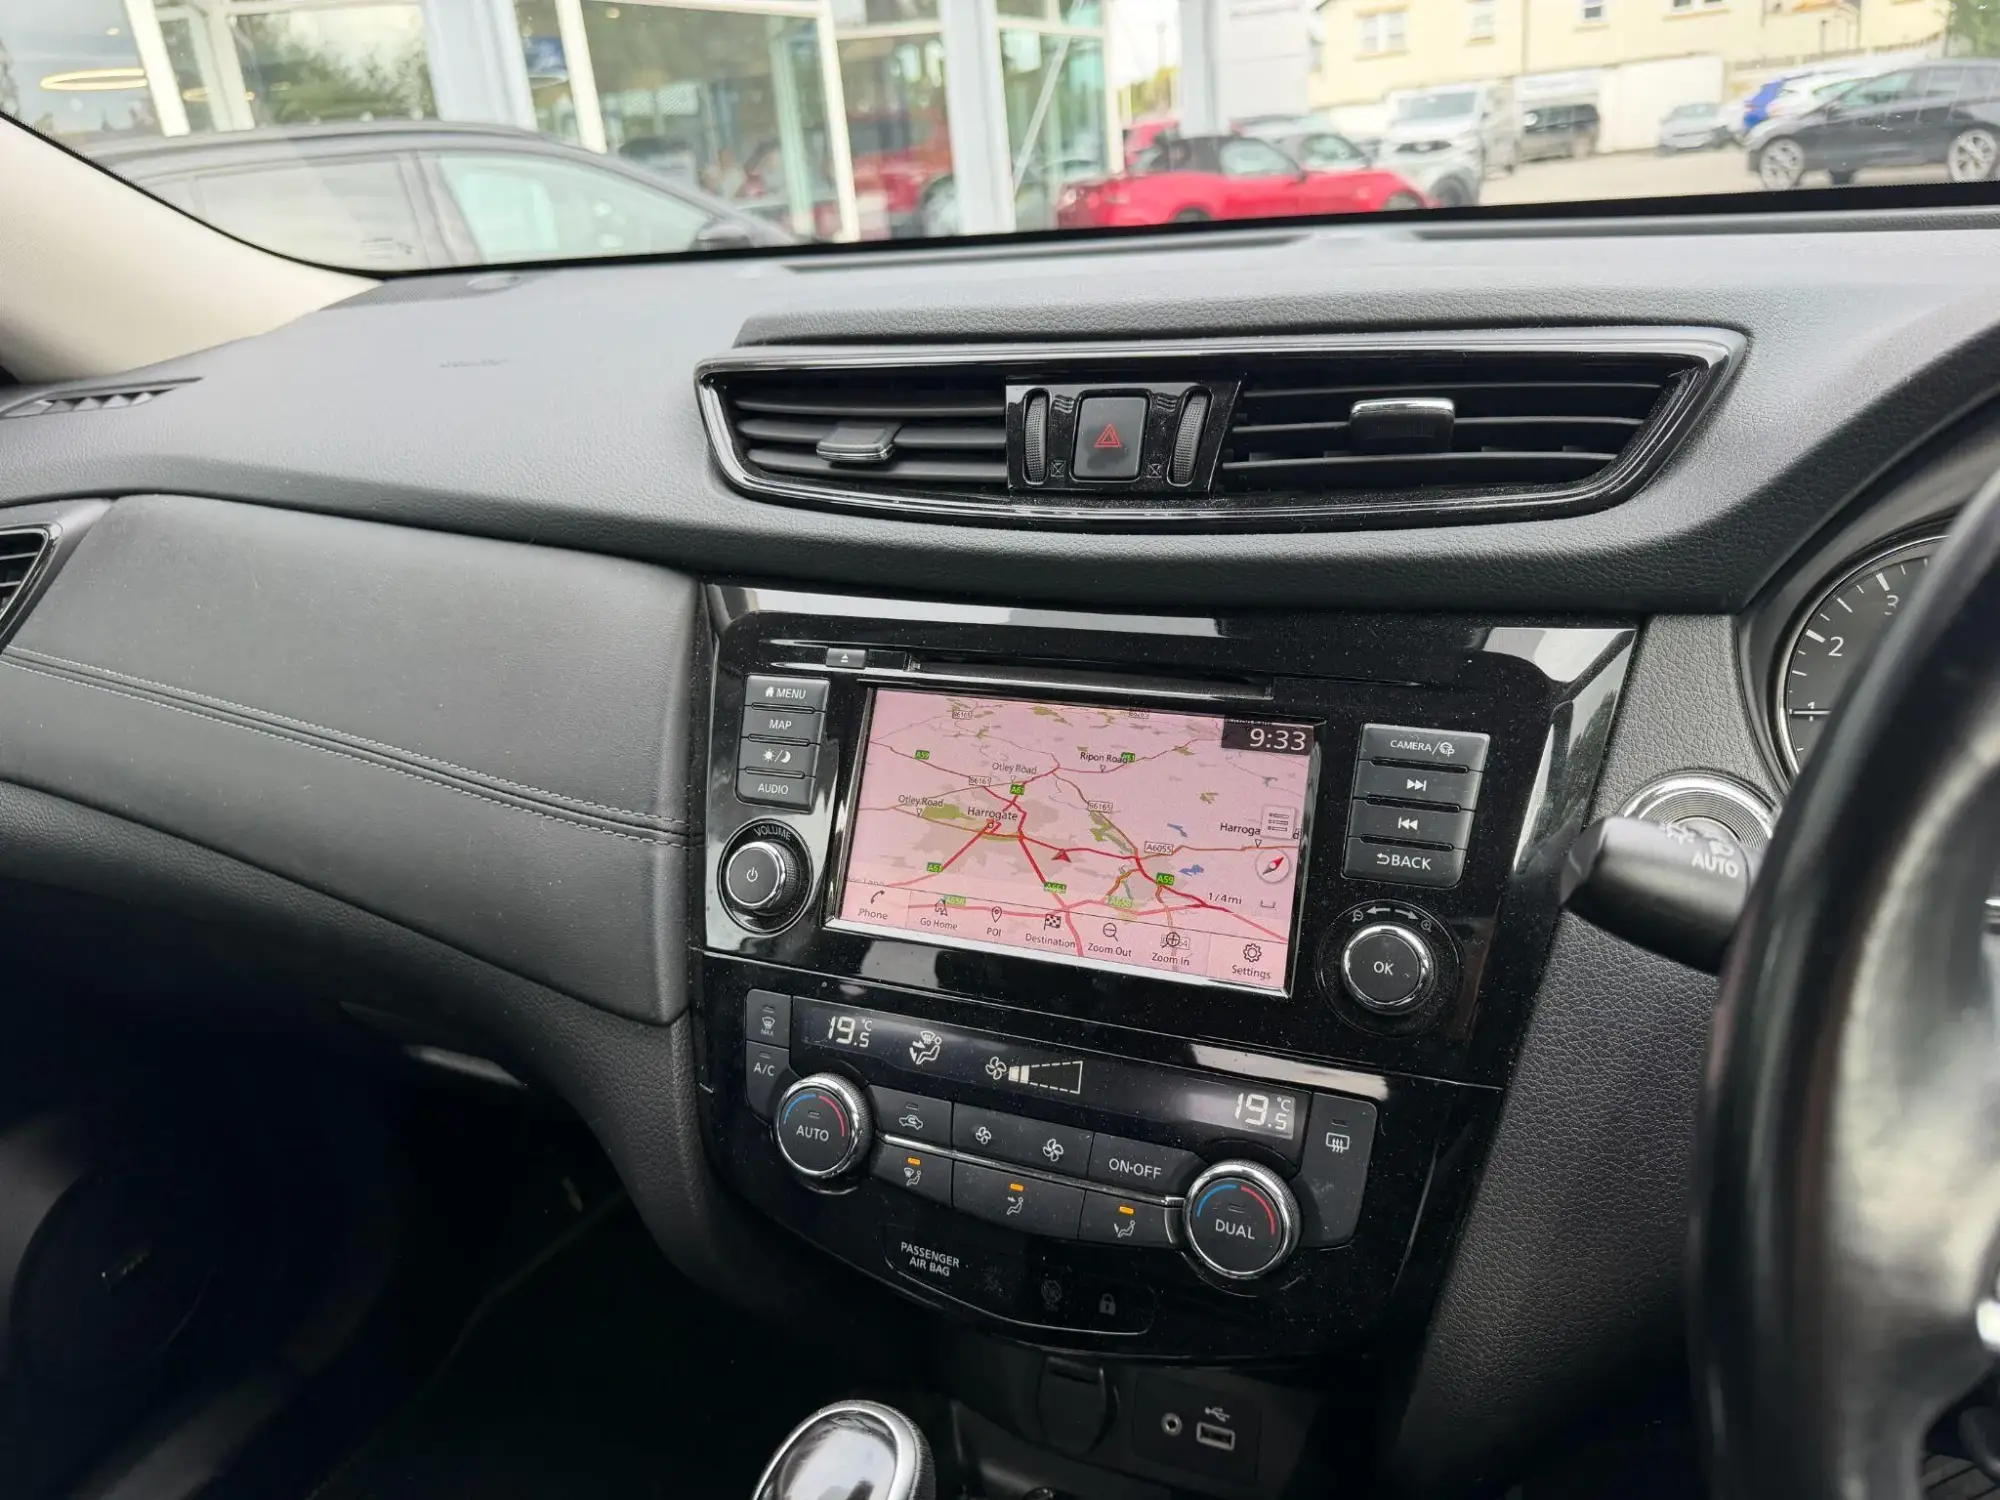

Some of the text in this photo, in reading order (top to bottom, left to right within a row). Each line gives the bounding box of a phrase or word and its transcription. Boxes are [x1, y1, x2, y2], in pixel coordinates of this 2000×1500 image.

[1828, 637, 1844, 656] 2
[776, 687, 807, 700] MENU
[769, 718, 792, 731] MAP
[1250, 728, 1307, 751] 9:33
[1080, 752, 1128, 764] Ripon Road
[992, 762, 1037, 775] Otley Road
[758, 783, 789, 795] AUDIO
[898, 795, 944, 808] Otley Road
[967, 806, 1019, 822] Harrogate
[753, 825, 791, 842] VOLUME
[1220, 822, 1261, 837] Harroga
[1146, 843, 1172, 853] A6055
[1391, 854, 1432, 870] BACK
[1691, 851, 1739, 878] AUTO
[1157, 874, 1174, 885] A59
[1209, 892, 1242, 905] 1/4mi
[858, 908, 888, 920] Phone
[920, 917, 958, 931] Go Home
[986, 927, 1002, 937] POI
[1025, 933, 1076, 949] Destination
[1087, 942, 1132, 958] Zoom Out
[1152, 952, 1190, 967] Zoom In
[1231, 964, 1272, 980] Settings
[1373, 960, 1394, 976] OK
[753, 1061, 775, 1077] A/C
[796, 1124, 830, 1142] AUTO
[1215, 1218, 1256, 1240] DUAL
[900, 1241, 960, 1268] PASSENGER
[909, 1256, 950, 1277] AIR BAG
